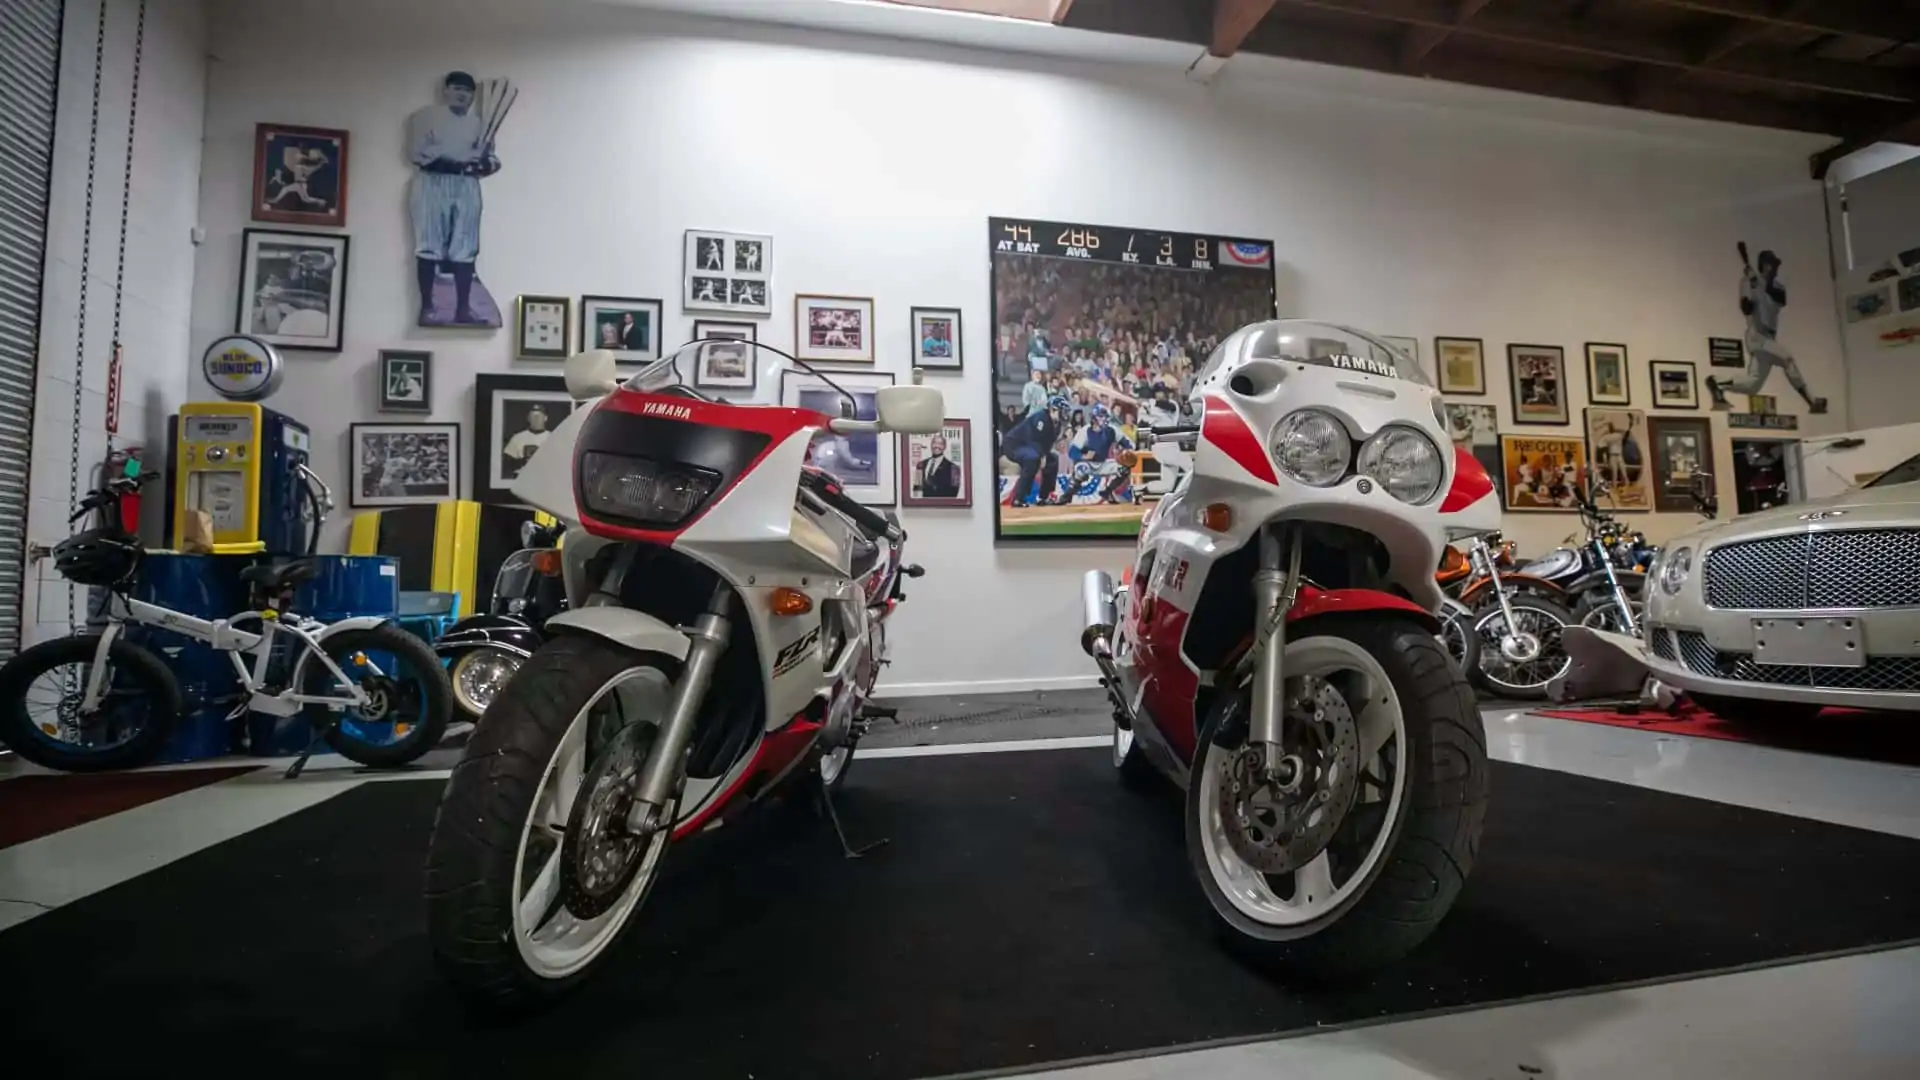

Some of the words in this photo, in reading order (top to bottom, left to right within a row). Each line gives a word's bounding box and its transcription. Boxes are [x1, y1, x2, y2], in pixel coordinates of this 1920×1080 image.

[997, 240, 1014, 250] AT
[1017, 242, 1040, 253] BAT
[1160, 235, 1172, 256] 3
[1195, 238, 1208, 259] 8
[210, 361, 263, 375] SUNOCO
[1329, 353, 1398, 379] YAMAHA
[642, 401, 691, 420] YAMAHA
[1513, 440, 1577, 454] REGGIE
